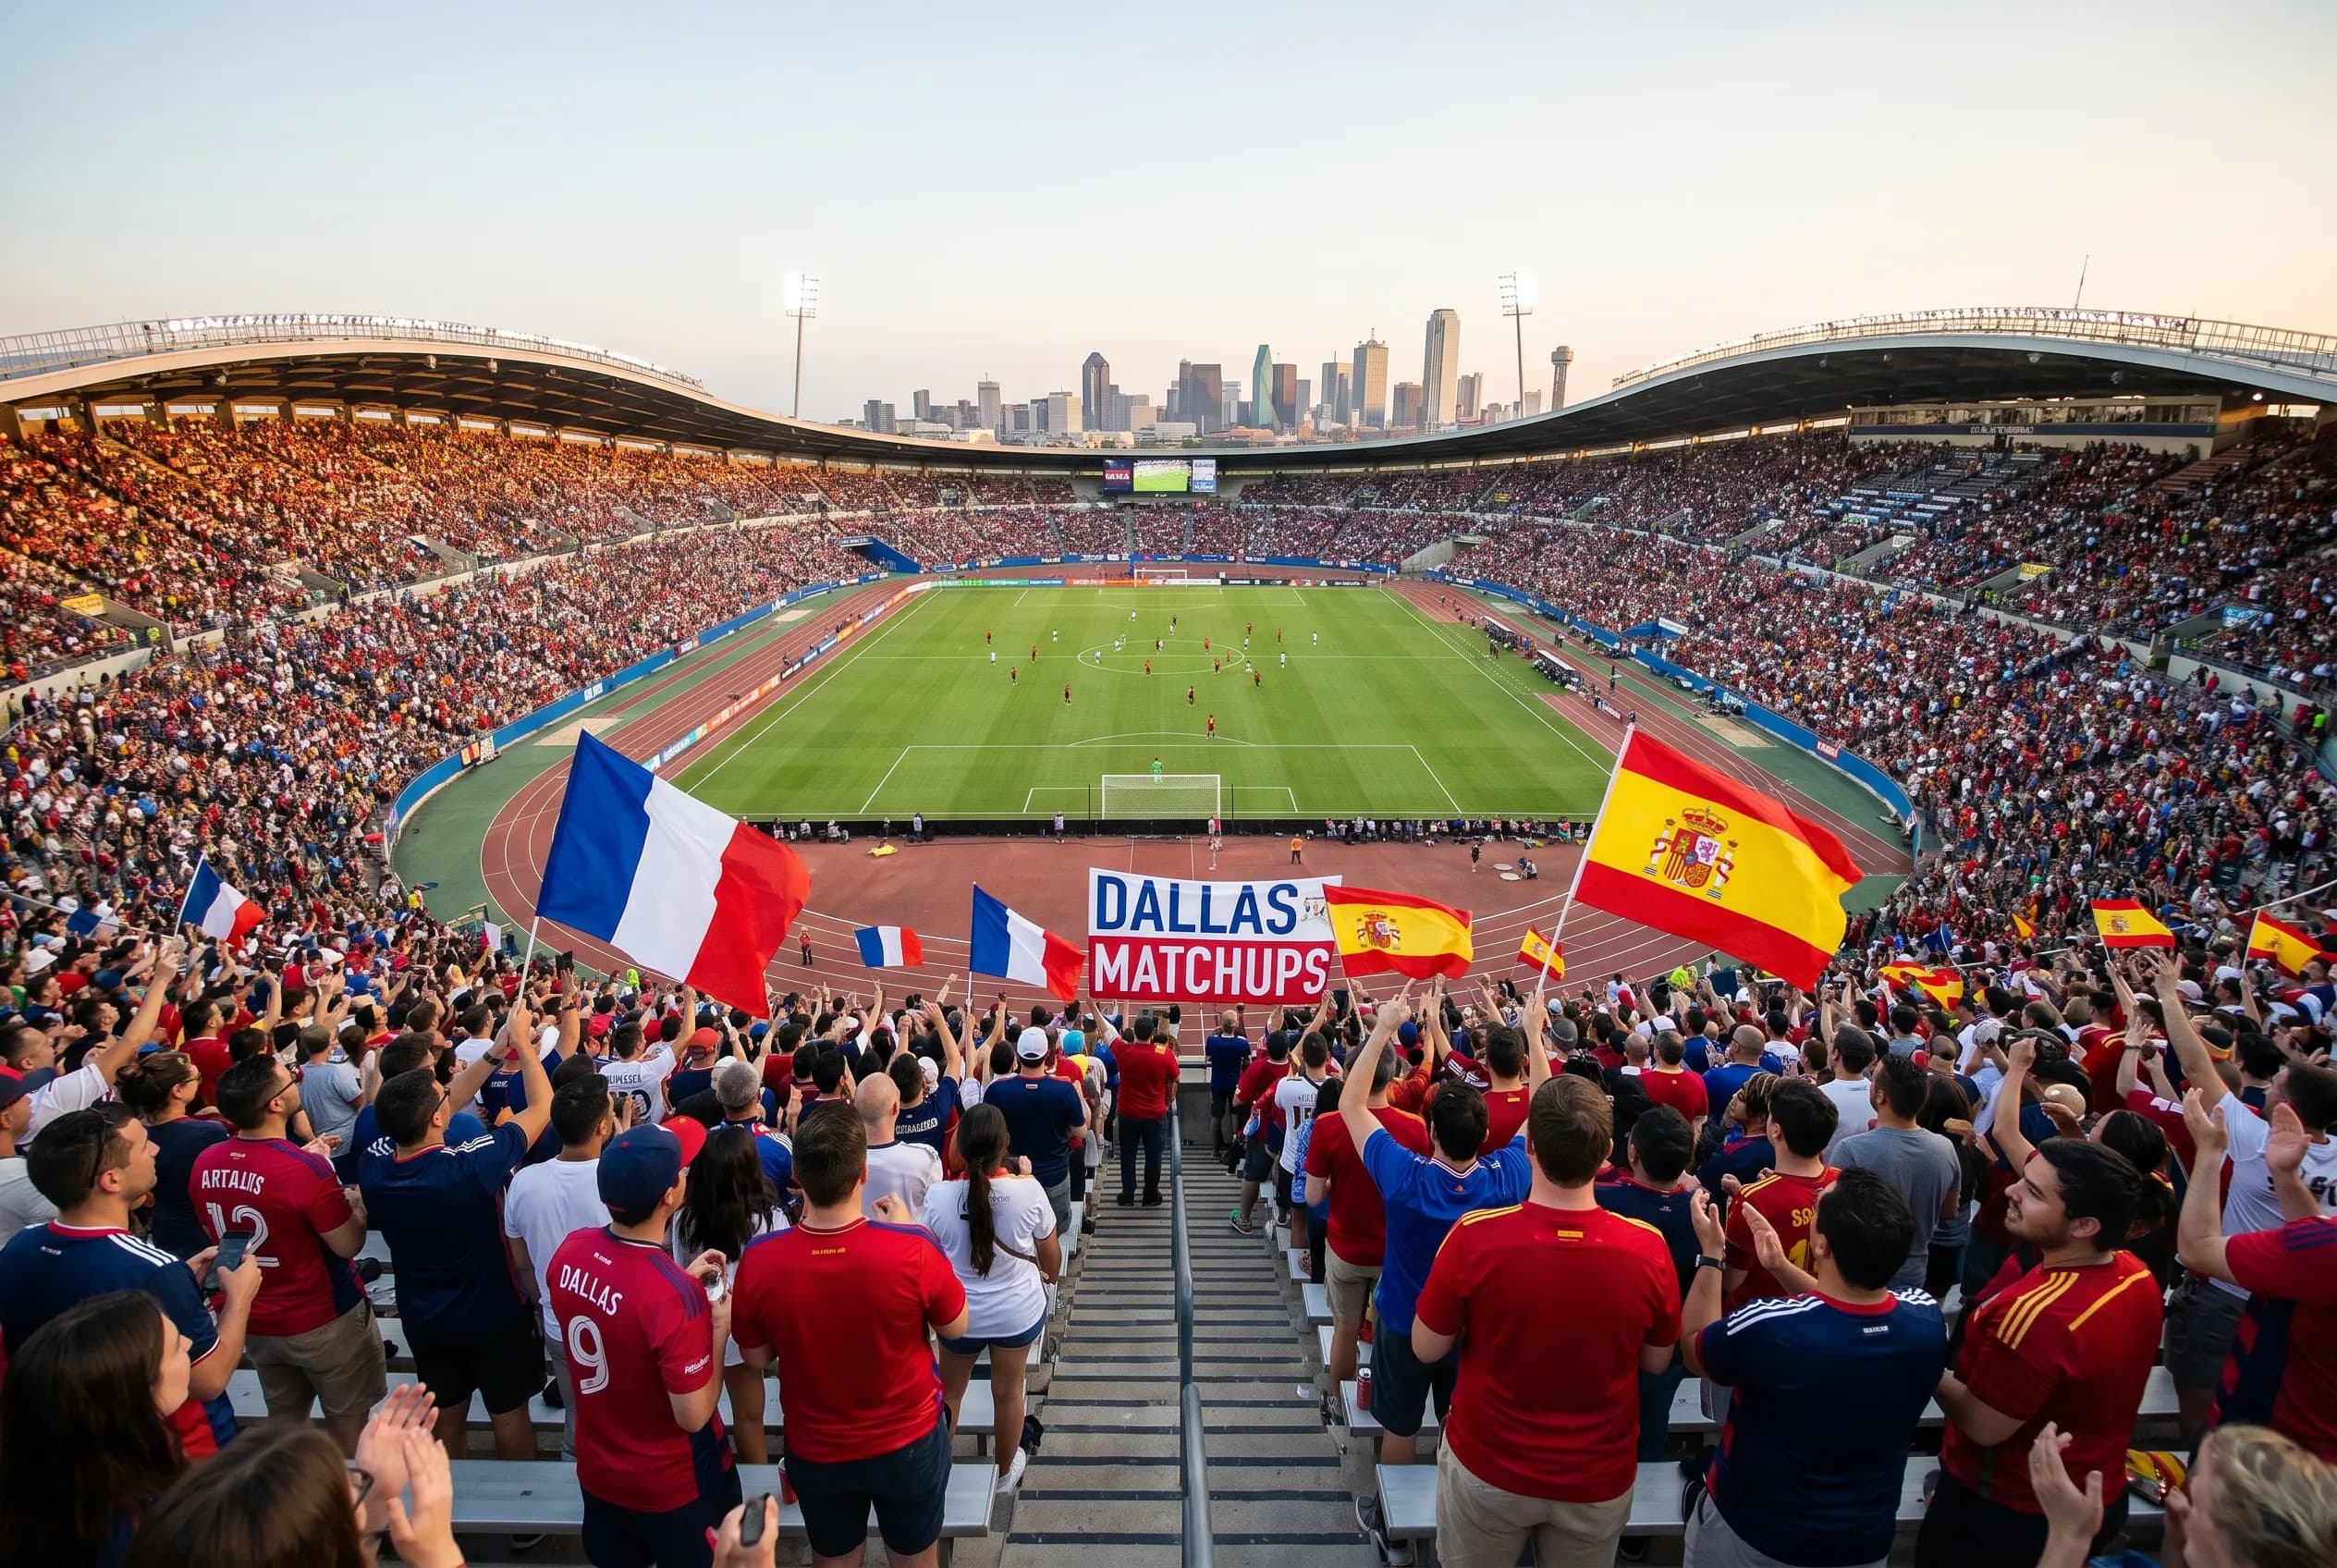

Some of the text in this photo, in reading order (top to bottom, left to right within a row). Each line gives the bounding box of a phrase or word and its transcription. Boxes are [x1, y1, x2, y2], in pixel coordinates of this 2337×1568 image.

[1096, 875, 1299, 935] DALLAS
[1095, 943, 1329, 997] MATCHUPS
[559, 1265, 623, 1316] DALLAS
[568, 1316, 609, 1395] 9
